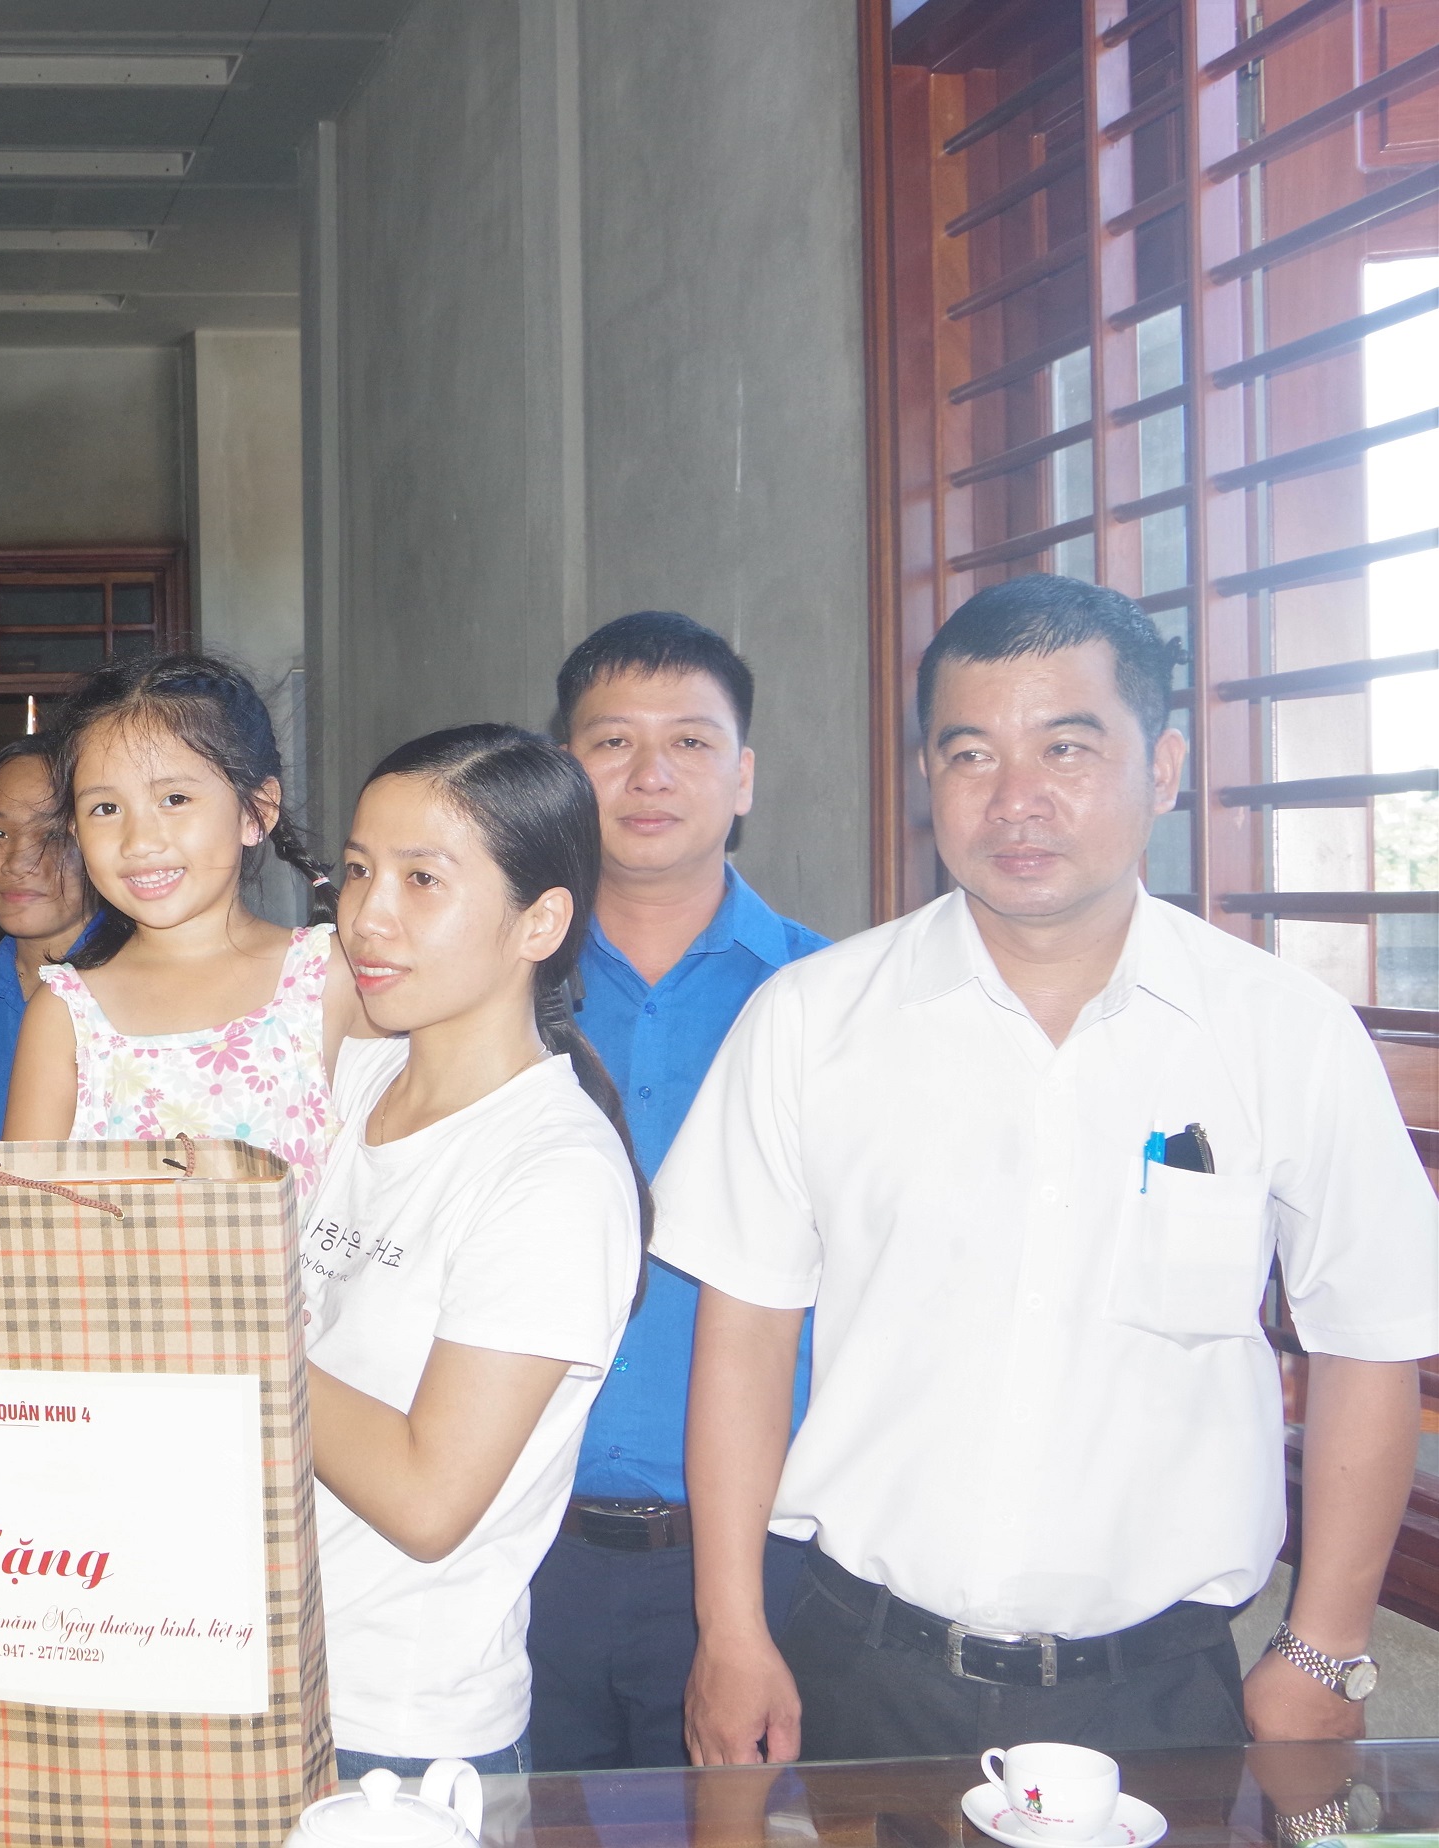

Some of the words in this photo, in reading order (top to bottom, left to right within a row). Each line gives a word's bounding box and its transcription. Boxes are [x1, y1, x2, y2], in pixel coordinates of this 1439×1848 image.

[45, 1405, 76, 1423] KHU
[81, 1407, 91, 1423] 4
[0, 1615, 37, 1631] năm
[99, 1614, 155, 1648] thương
[207, 1618, 233, 1643] liệt
[37, 1645, 105, 1663] 27/7/2022)
